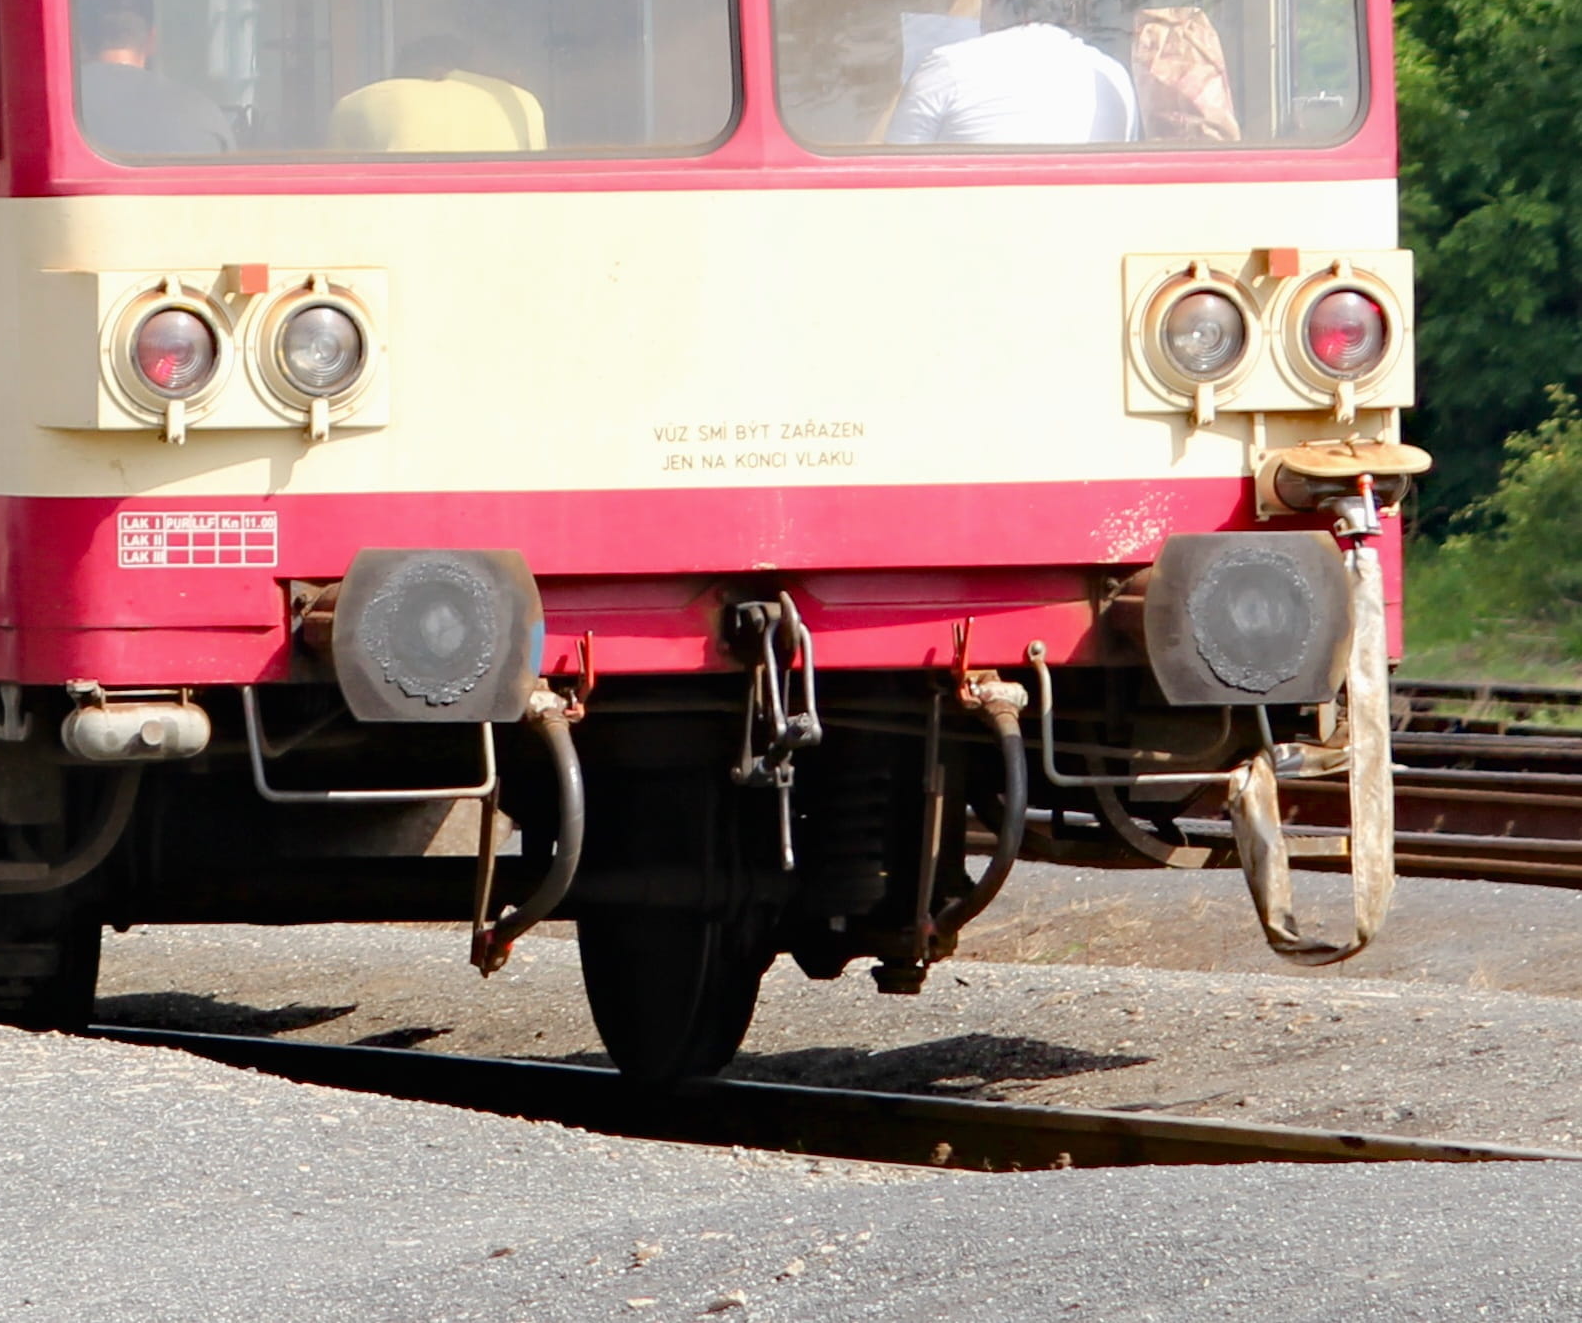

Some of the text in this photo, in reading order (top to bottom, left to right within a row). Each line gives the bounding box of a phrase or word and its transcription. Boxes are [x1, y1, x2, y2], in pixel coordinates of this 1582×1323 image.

[735, 420, 771, 441] BÝT
[780, 419, 865, 440] ZAŘAZEN
[662, 450, 855, 471] JEN NA KONCI VLAKU
[123, 517, 149, 529] LAK
[165, 517, 190, 530] PUR
[192, 516, 216, 529] LLF
[220, 517, 241, 529] Kn
[123, 534, 162, 546] LAK II
[123, 551, 166, 563] LAK III
